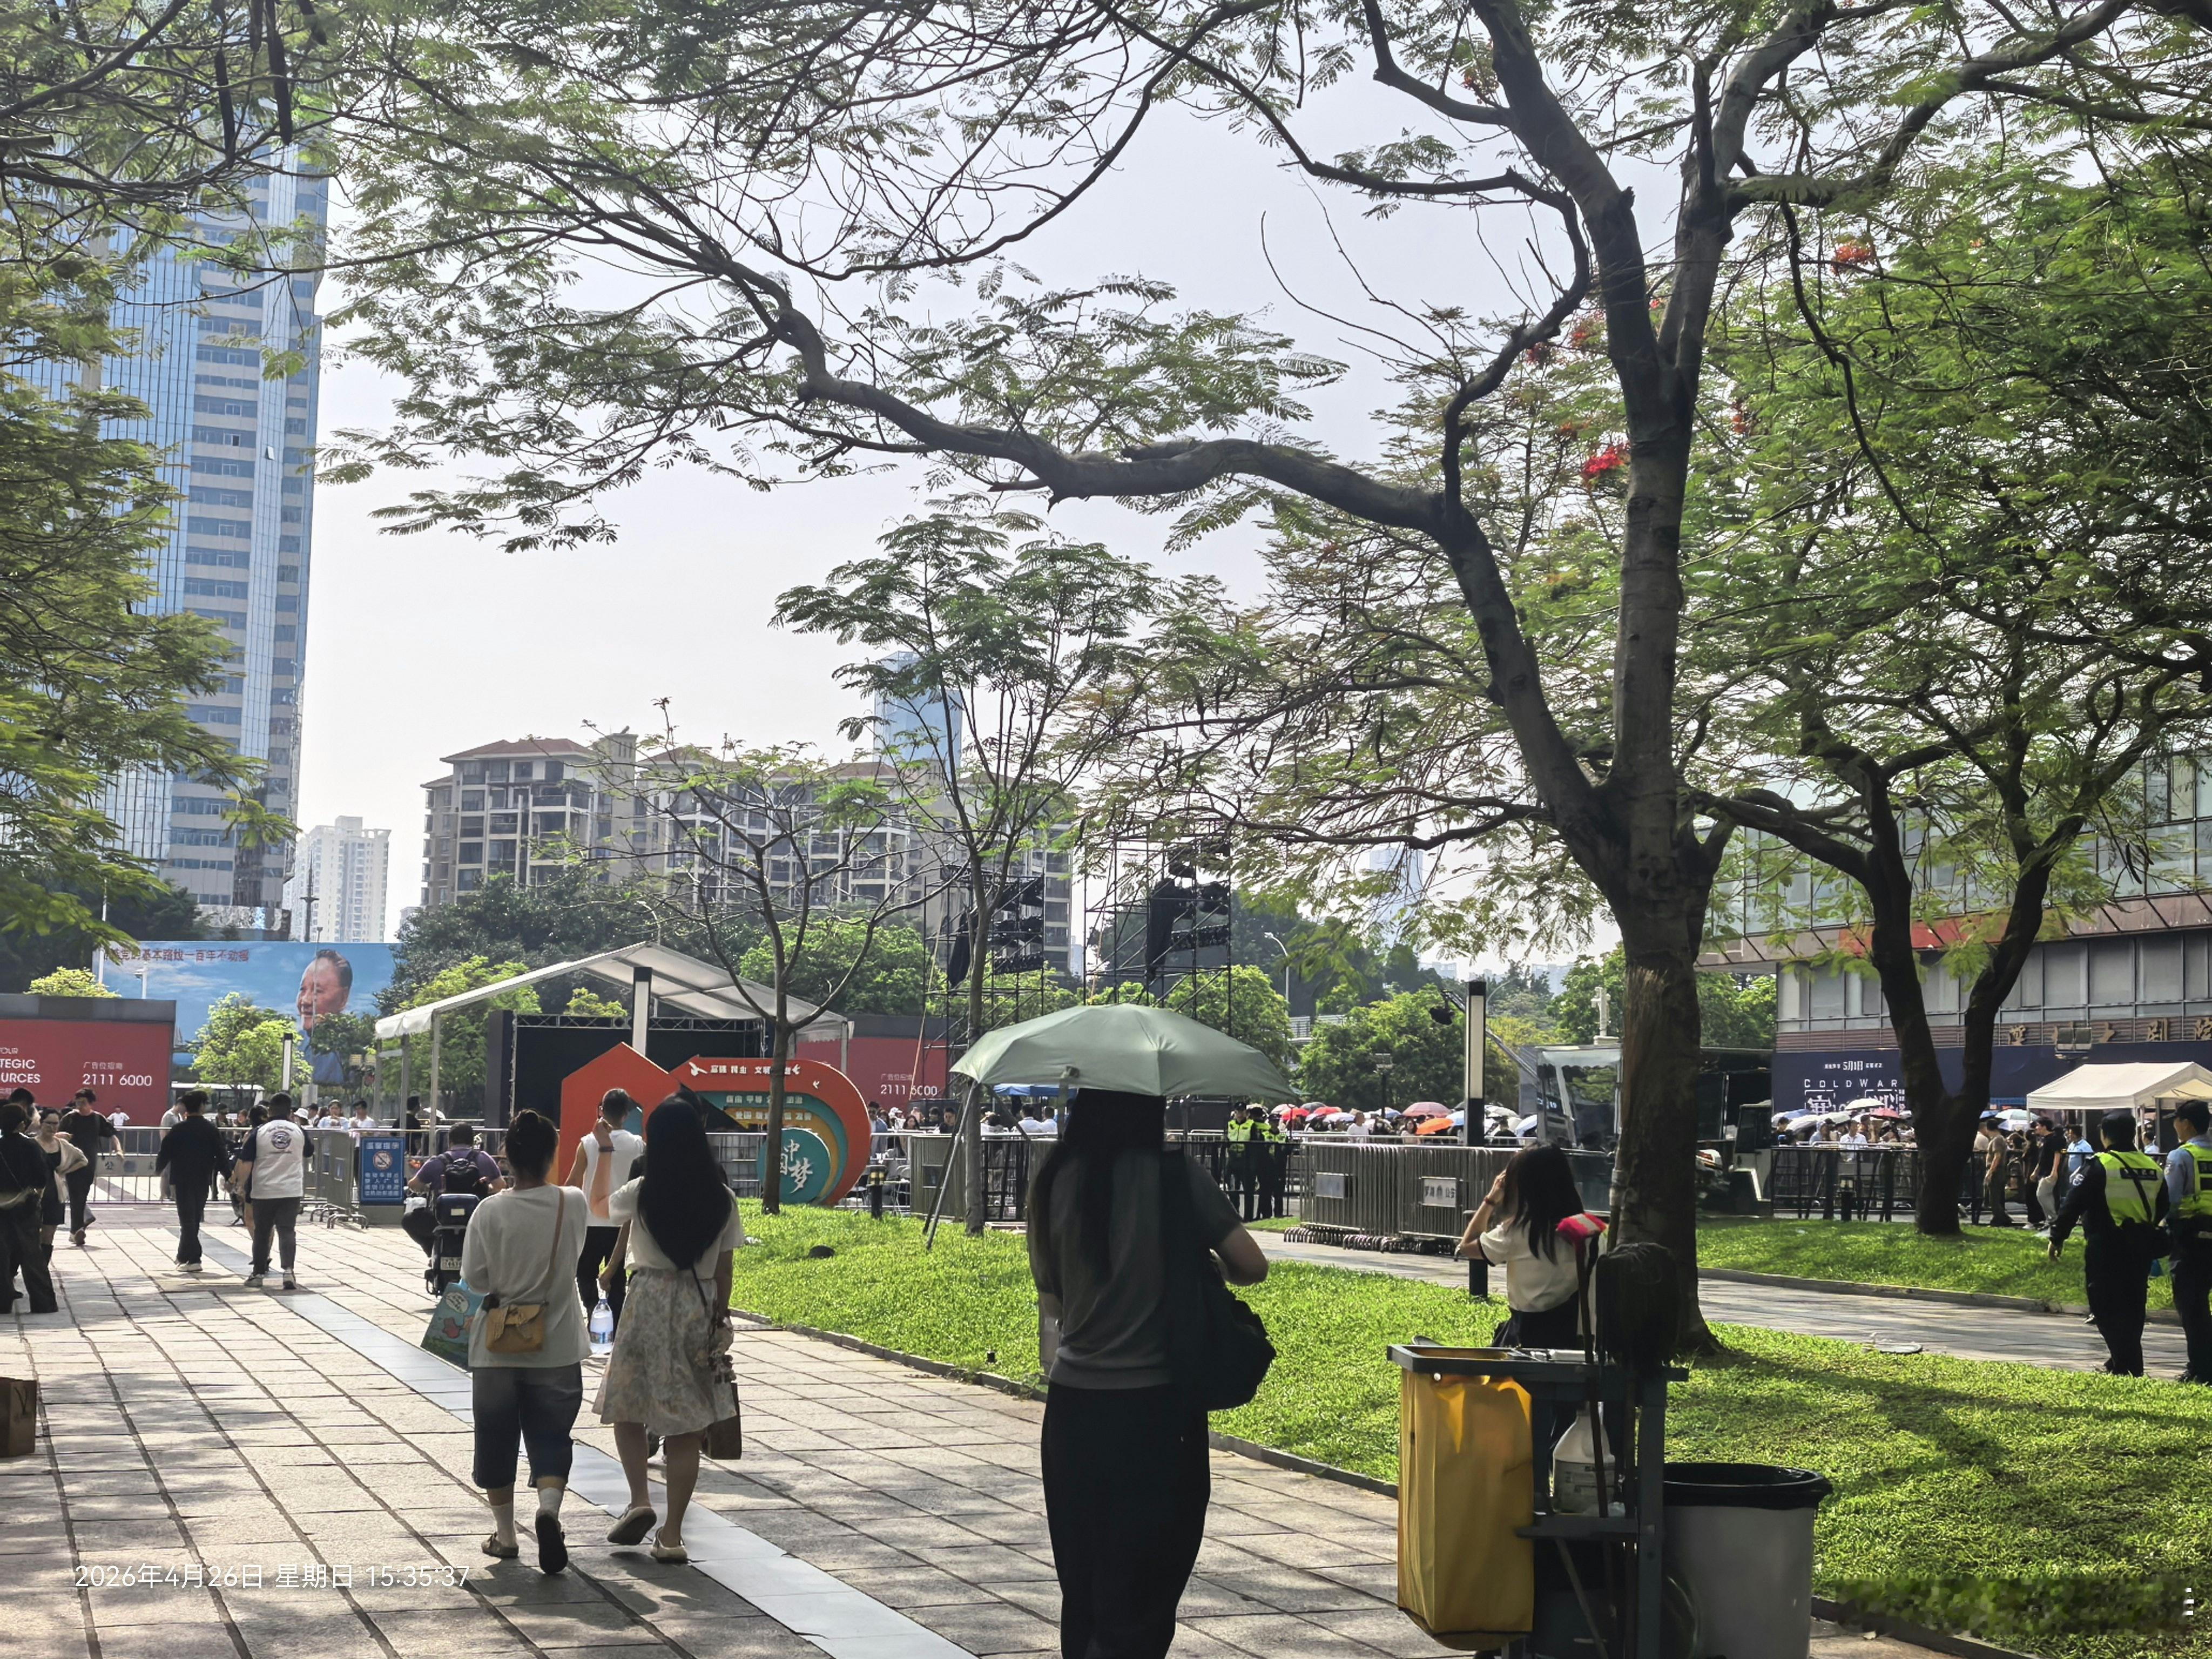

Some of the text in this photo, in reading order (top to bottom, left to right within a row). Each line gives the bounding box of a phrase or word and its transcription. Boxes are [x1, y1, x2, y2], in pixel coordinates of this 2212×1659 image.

[83, 1073, 152, 1087] 2111 6000
[880, 1084, 905, 1095] 2111
